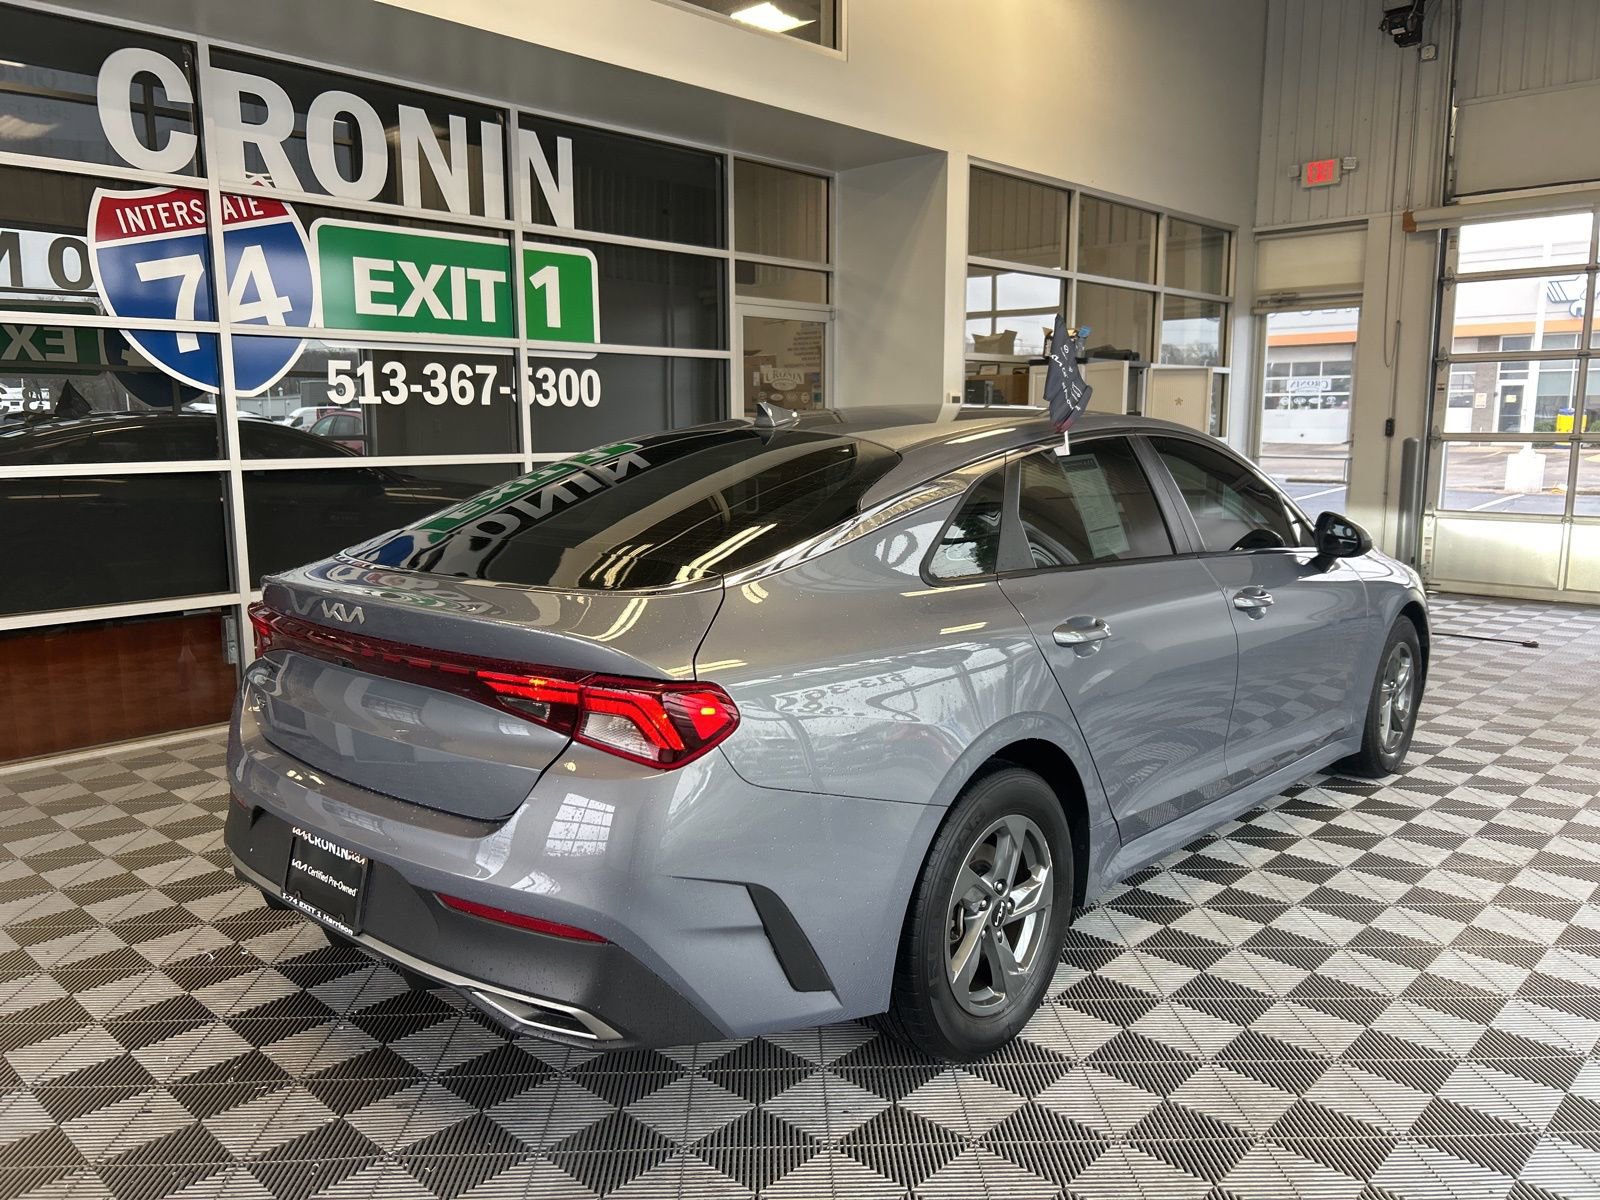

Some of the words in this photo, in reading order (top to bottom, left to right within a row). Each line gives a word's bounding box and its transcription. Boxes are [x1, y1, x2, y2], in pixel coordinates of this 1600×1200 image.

[97, 47, 575, 230] CRONIN
[115, 195, 265, 234] INTERSATE
[135, 244, 293, 354] 74
[352, 256, 507, 323] EXIT
[528, 265, 562, 328] 1
[307, 866, 329, 883] Certified
[328, 876, 358, 897] Pre-Owned
[282, 892, 298, 905] I-74
[298, 901, 317, 914] EXIT
[322, 913, 354, 936] Harrison
